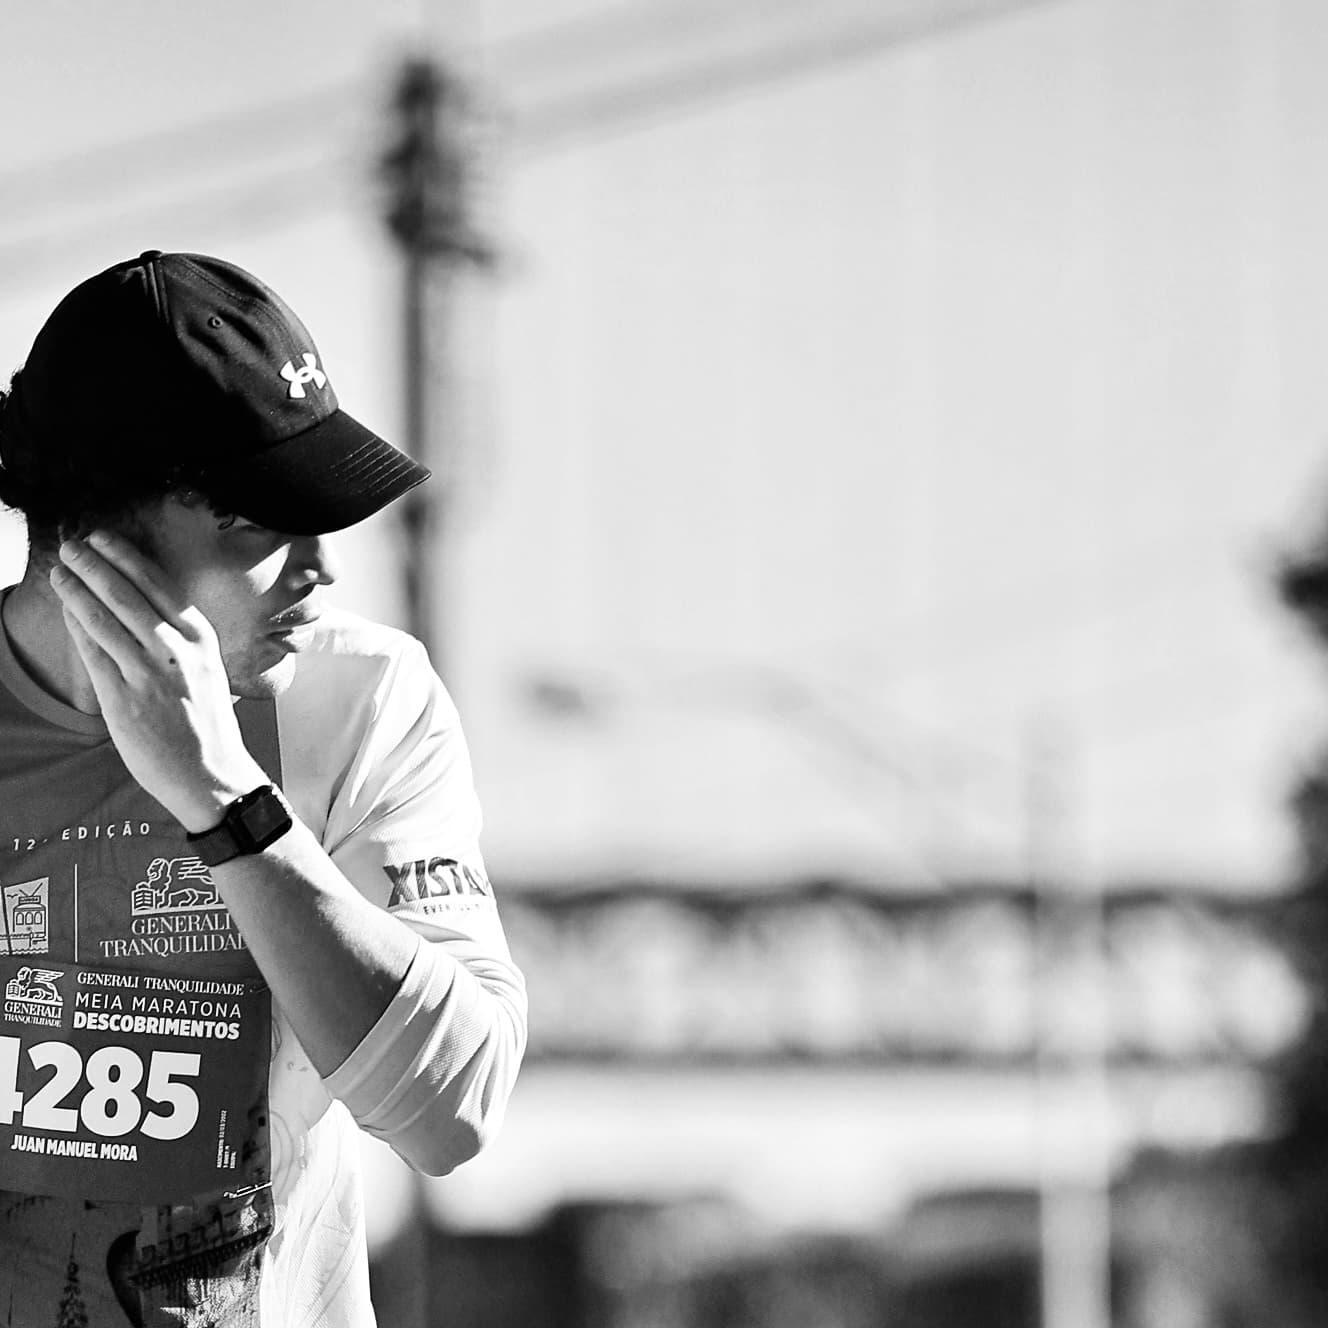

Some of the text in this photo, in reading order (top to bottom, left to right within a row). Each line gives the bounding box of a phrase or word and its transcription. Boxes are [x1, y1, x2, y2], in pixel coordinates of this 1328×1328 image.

[61, 820, 151, 840] EDIÇÃO
[131, 913, 232, 935] GENERALI
[77, 971, 245, 996] GENERALI TRANQUILIDADE
[4, 1000, 62, 1019] GENERALI
[75, 991, 242, 1019] MEIA MARATONA
[73, 1011, 240, 1040] DESCOBRIMENTOS
[10, 1134, 138, 1161] JUAN MANUEL MORA
